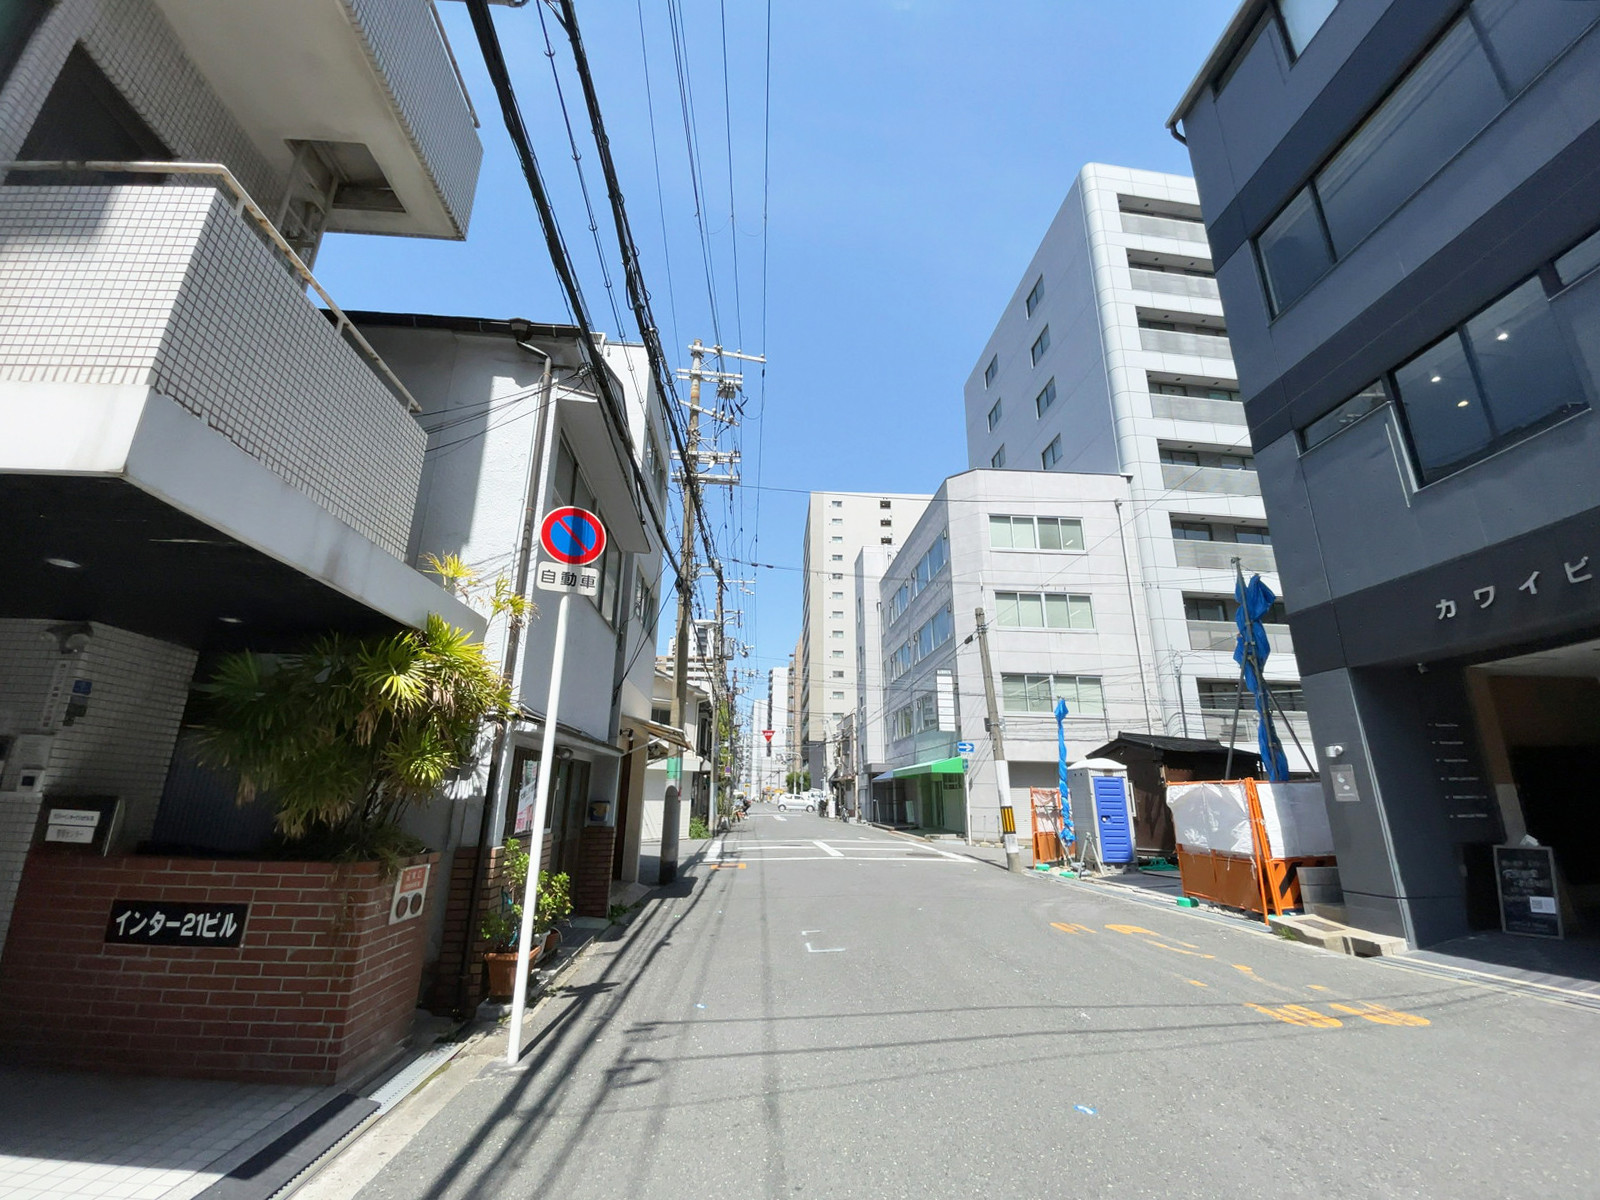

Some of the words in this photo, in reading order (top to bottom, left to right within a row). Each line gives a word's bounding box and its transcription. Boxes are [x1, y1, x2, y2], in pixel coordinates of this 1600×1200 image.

[541, 569, 596, 589] 自動車
[1434, 555, 1593, 620] カワイビ
[115, 910, 238, 938] インター21ビル
